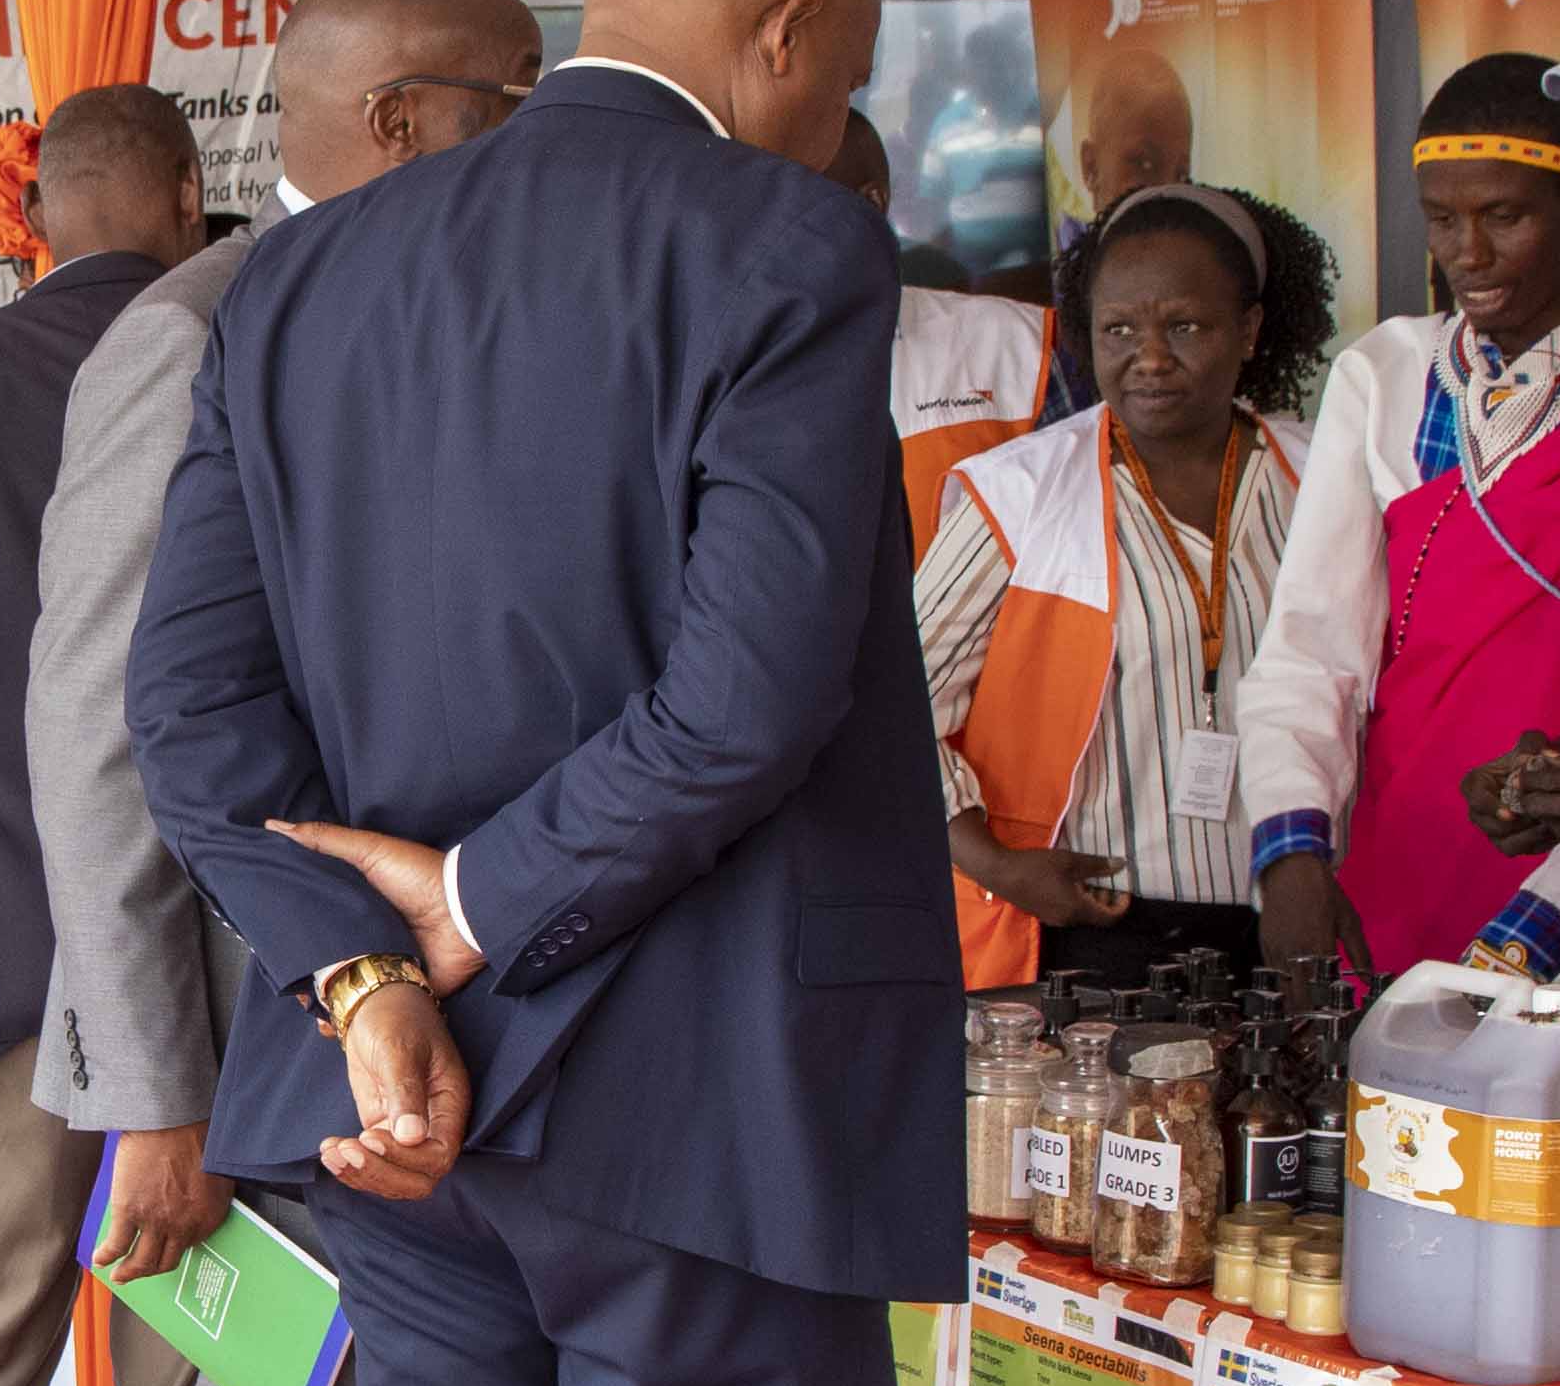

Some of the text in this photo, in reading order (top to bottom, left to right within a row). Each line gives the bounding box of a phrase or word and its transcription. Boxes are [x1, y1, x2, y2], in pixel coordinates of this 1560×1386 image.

[1494, 1128, 1543, 1143] POKOT
[1107, 1139, 1163, 1169] LUMPS
[1493, 1146, 1544, 1161] HONEY
[1104, 1172, 1175, 1203] GRADE 3
[1002, 1289, 1038, 1314] Sverige
[1023, 1326, 1148, 1384] Seena spectabilis
